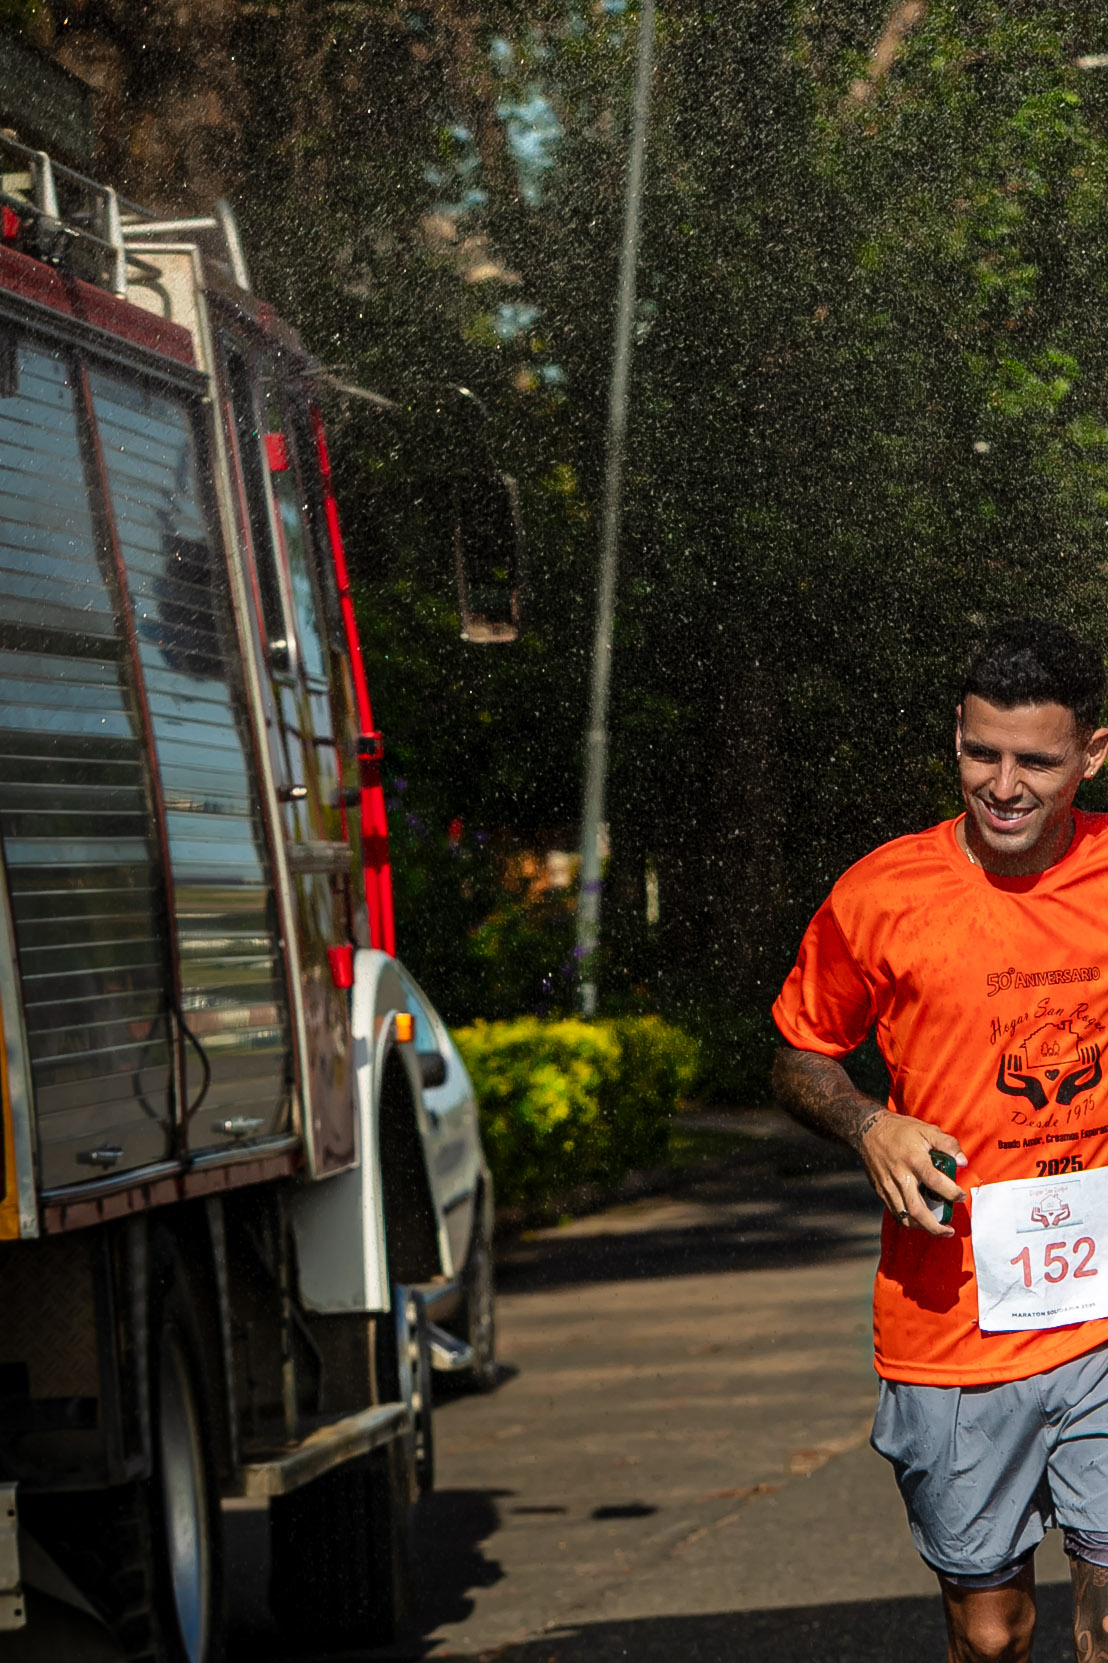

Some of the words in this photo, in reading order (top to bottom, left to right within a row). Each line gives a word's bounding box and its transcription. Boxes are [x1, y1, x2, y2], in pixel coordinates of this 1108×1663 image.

[1014, 966, 1100, 989] ANIVERSARIO
[990, 1012, 1029, 1045] Hogar
[1034, 998, 1064, 1018] San
[1069, 1002, 1106, 1032] Roque
[1011, 1111, 1059, 1128] Desde
[1066, 1094, 1095, 1124] 1975
[1036, 1154, 1083, 1177] 2025
[1010, 1236, 1098, 1288] 152
